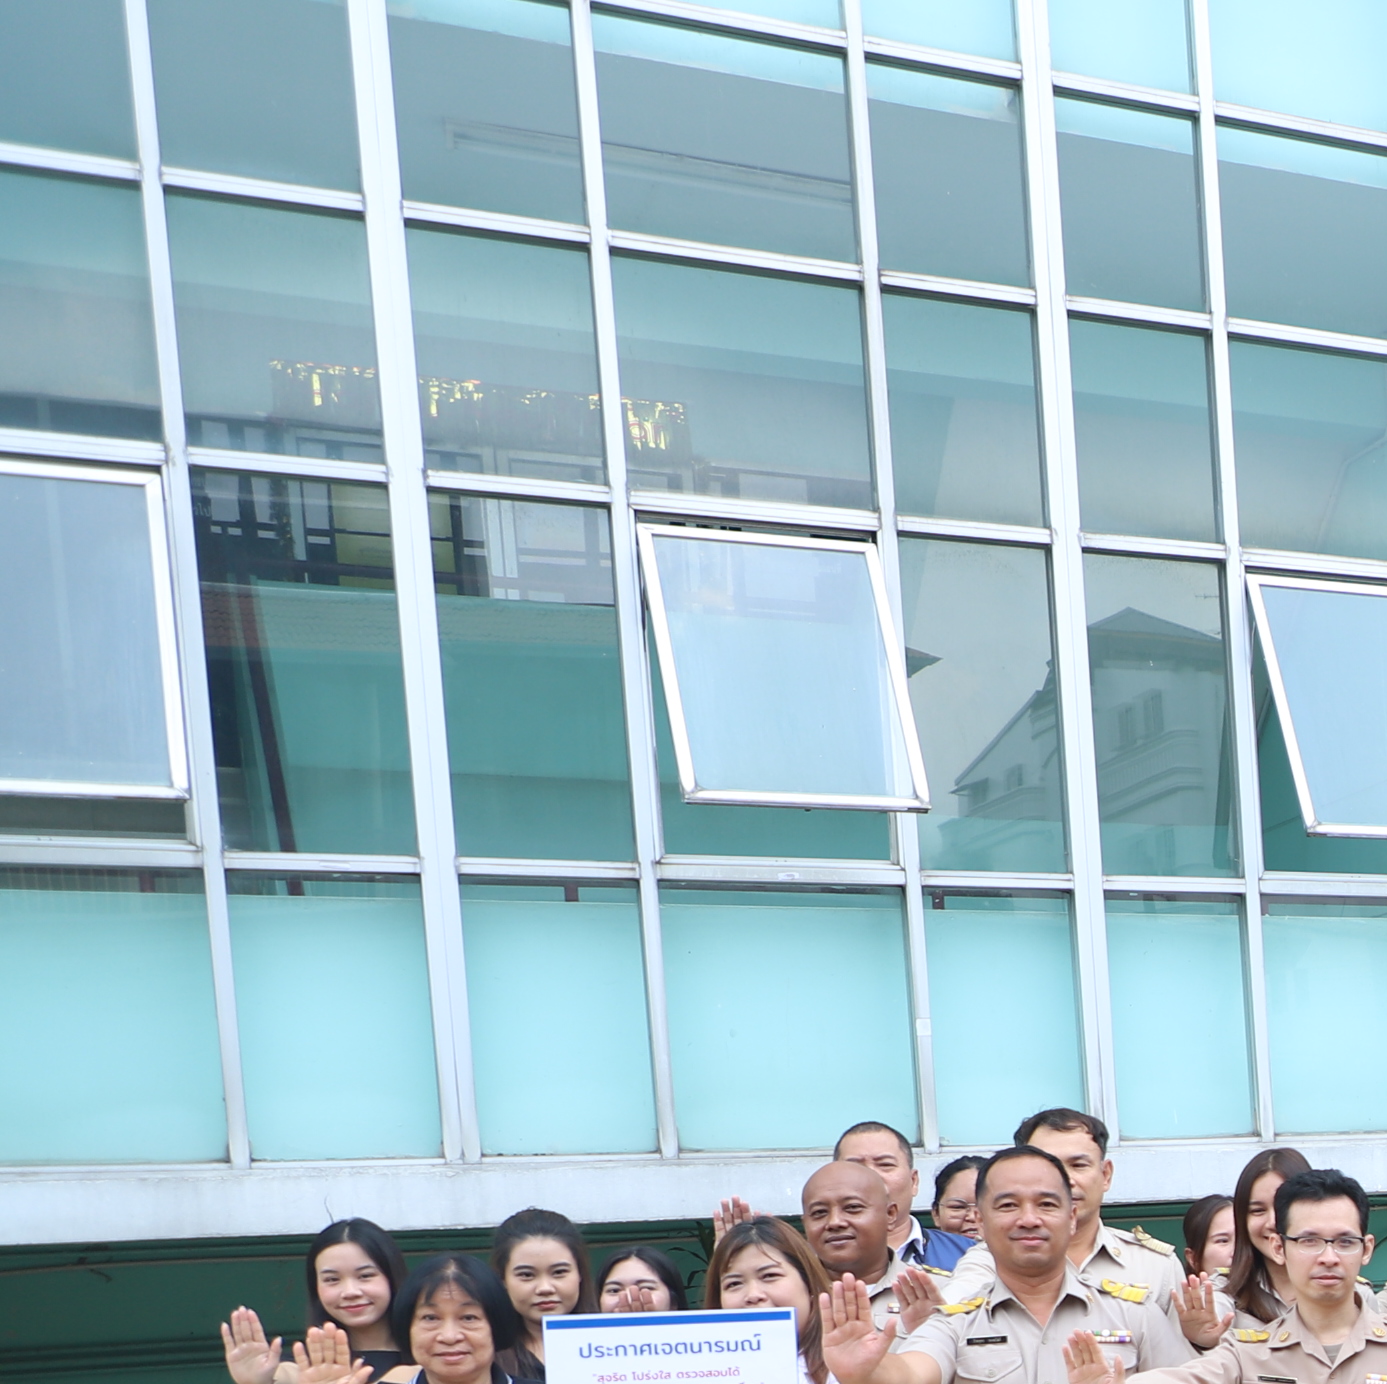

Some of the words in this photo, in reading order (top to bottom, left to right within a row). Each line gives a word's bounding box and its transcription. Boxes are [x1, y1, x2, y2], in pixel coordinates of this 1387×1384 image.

[579, 1334, 762, 1359] ประกาศเจตนารมณ์
[633, 1369, 671, 1382] โปร่งใส
[677, 1367, 740, 1380] ตรวจสอบได้
